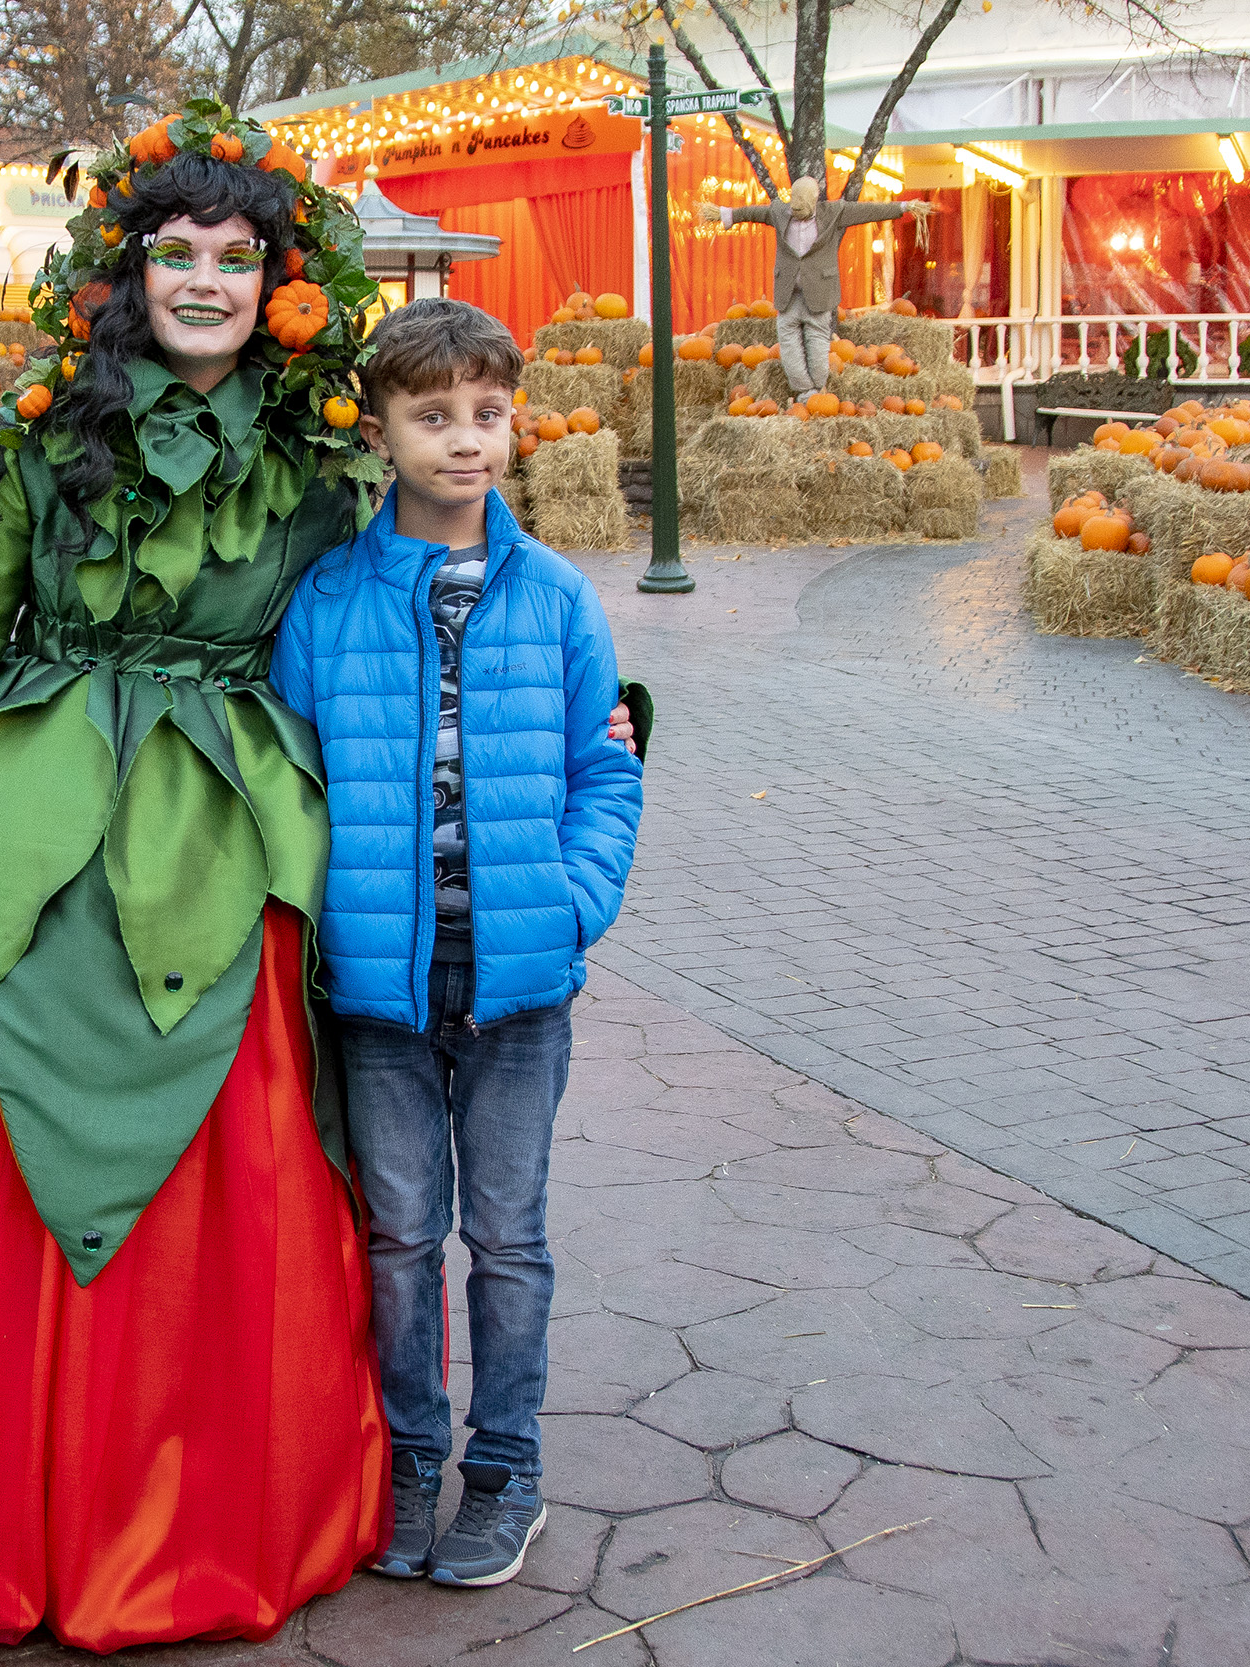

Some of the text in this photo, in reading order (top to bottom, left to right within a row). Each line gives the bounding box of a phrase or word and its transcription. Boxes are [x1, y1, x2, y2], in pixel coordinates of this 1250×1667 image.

[666, 93, 736, 114] SPANSKA TRAPPAN
[382, 139, 441, 165] Pumpkin
[467, 126, 549, 155] Pancakes
[31, 193, 85, 208] PRICA
[493, 662, 526, 675] everest
